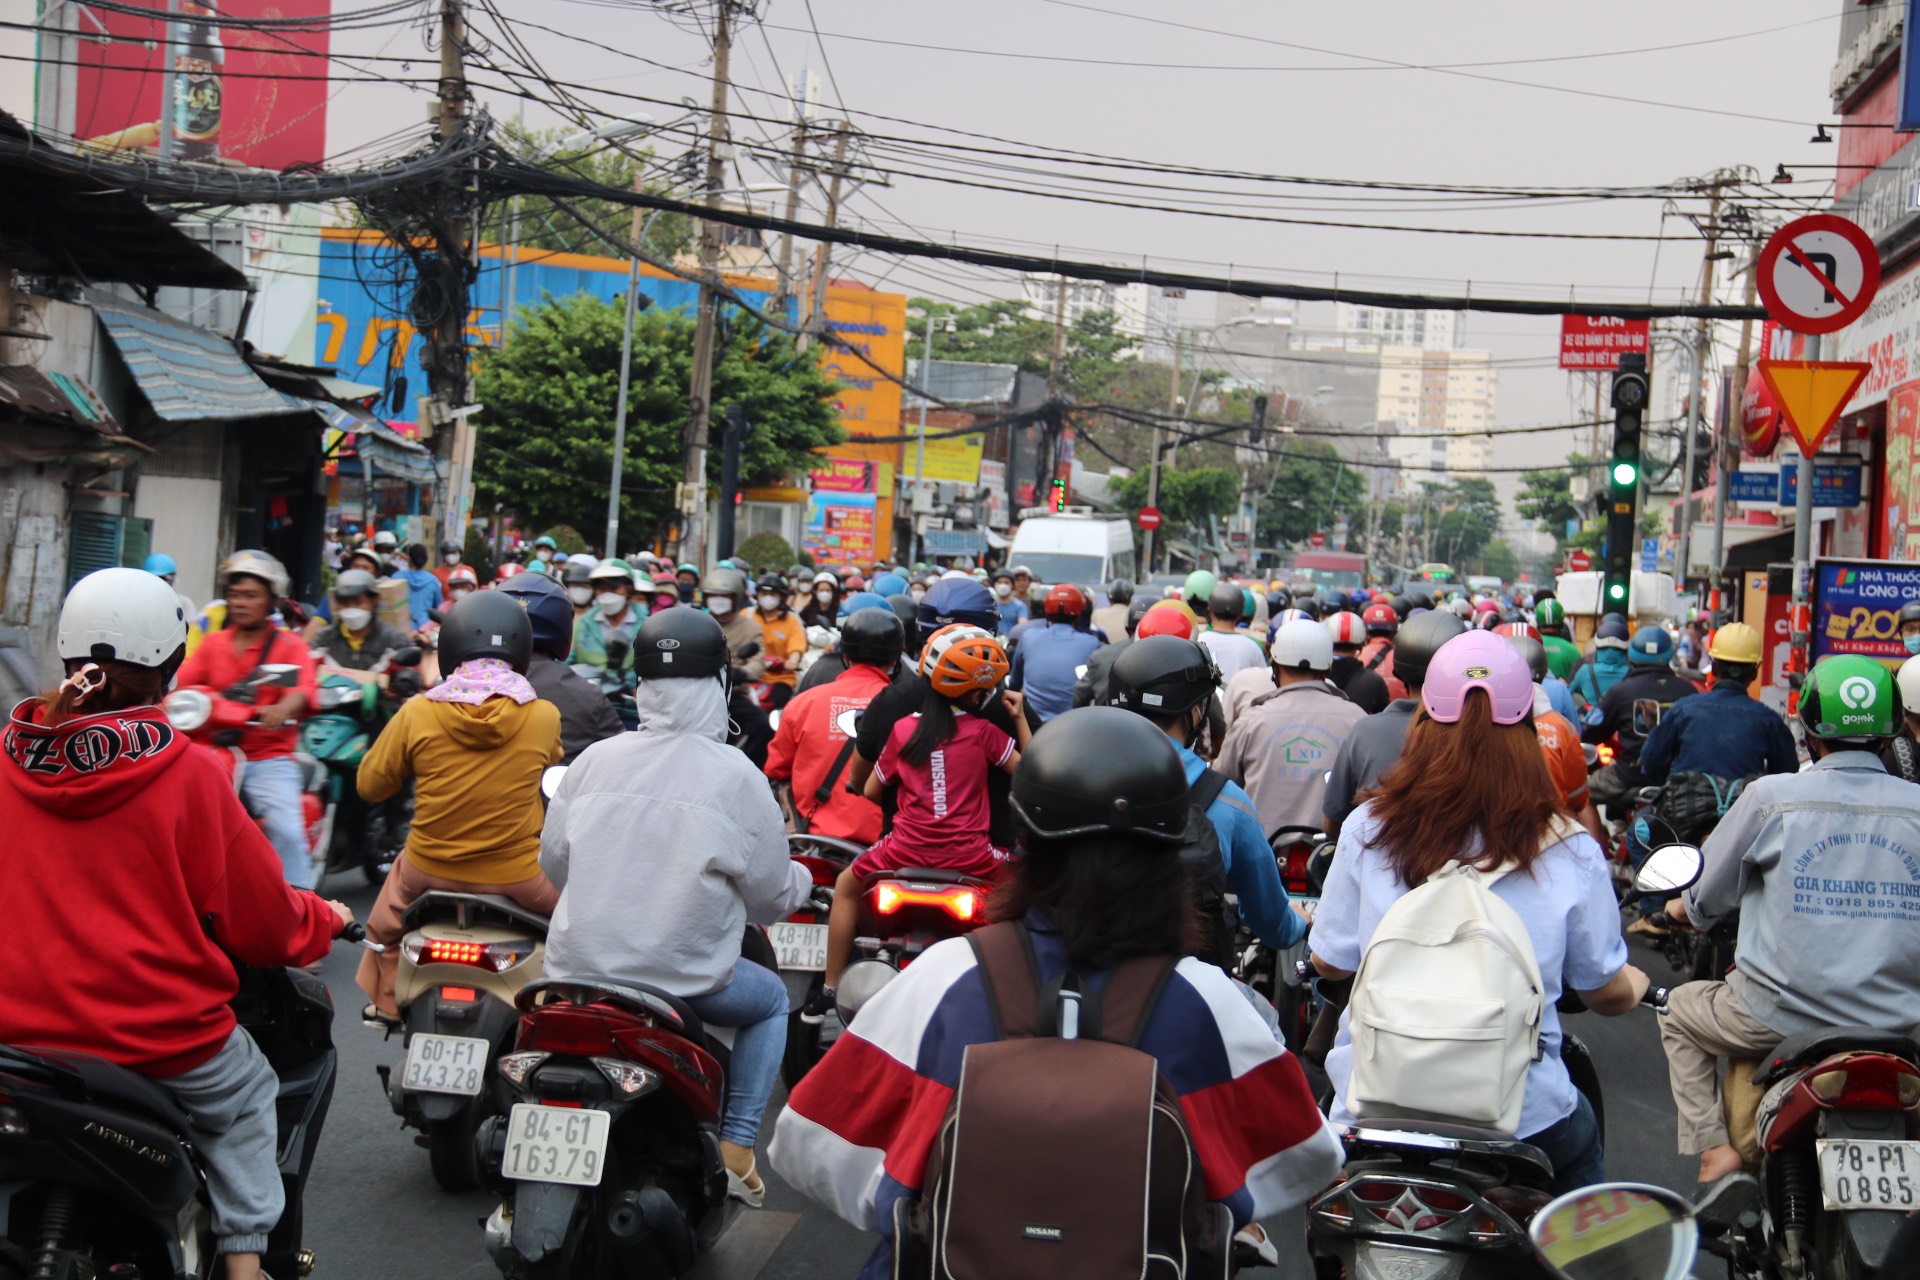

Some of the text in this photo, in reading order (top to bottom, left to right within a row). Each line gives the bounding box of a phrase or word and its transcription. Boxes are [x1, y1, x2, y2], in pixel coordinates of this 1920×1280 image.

[1564, 333, 1574, 346] XE
[1585, 331, 1603, 347] BÁNH
[1632, 331, 1644, 347] VÀO
[1595, 348, 1610, 365] VIẾT
[847, 404, 866, 419] LG
[1860, 569, 1920, 584] NHÀ THUỐC
[1859, 584, 1899, 598] LONG
[1842, 713, 1874, 725] gojek
[930, 749, 948, 819] VINSCHOOL
[1814, 839, 1826, 853] TY
[1828, 833, 1852, 847] TNHH
[1794, 876, 1920, 899] GIA KHANG THỊNH
[1793, 905, 1824, 915] Website
[1794, 893, 1812, 904] ĐT
[1826, 897, 1862, 907] 0918
[1868, 899, 1895, 909] 895
[1900, 901, 1920, 911] 425
[778, 926, 821, 945] 48-H1
[421, 1038, 475, 1065] 60-F1
[409, 1063, 479, 1091] 343.28
[524, 1110, 592, 1145] 84-G1
[511, 1143, 598, 1179] 163.79
[1832, 1144, 1906, 1173] 78-P1
[1837, 1176, 1914, 1205] 0895
[1025, 1226, 1061, 1237] INSANE
